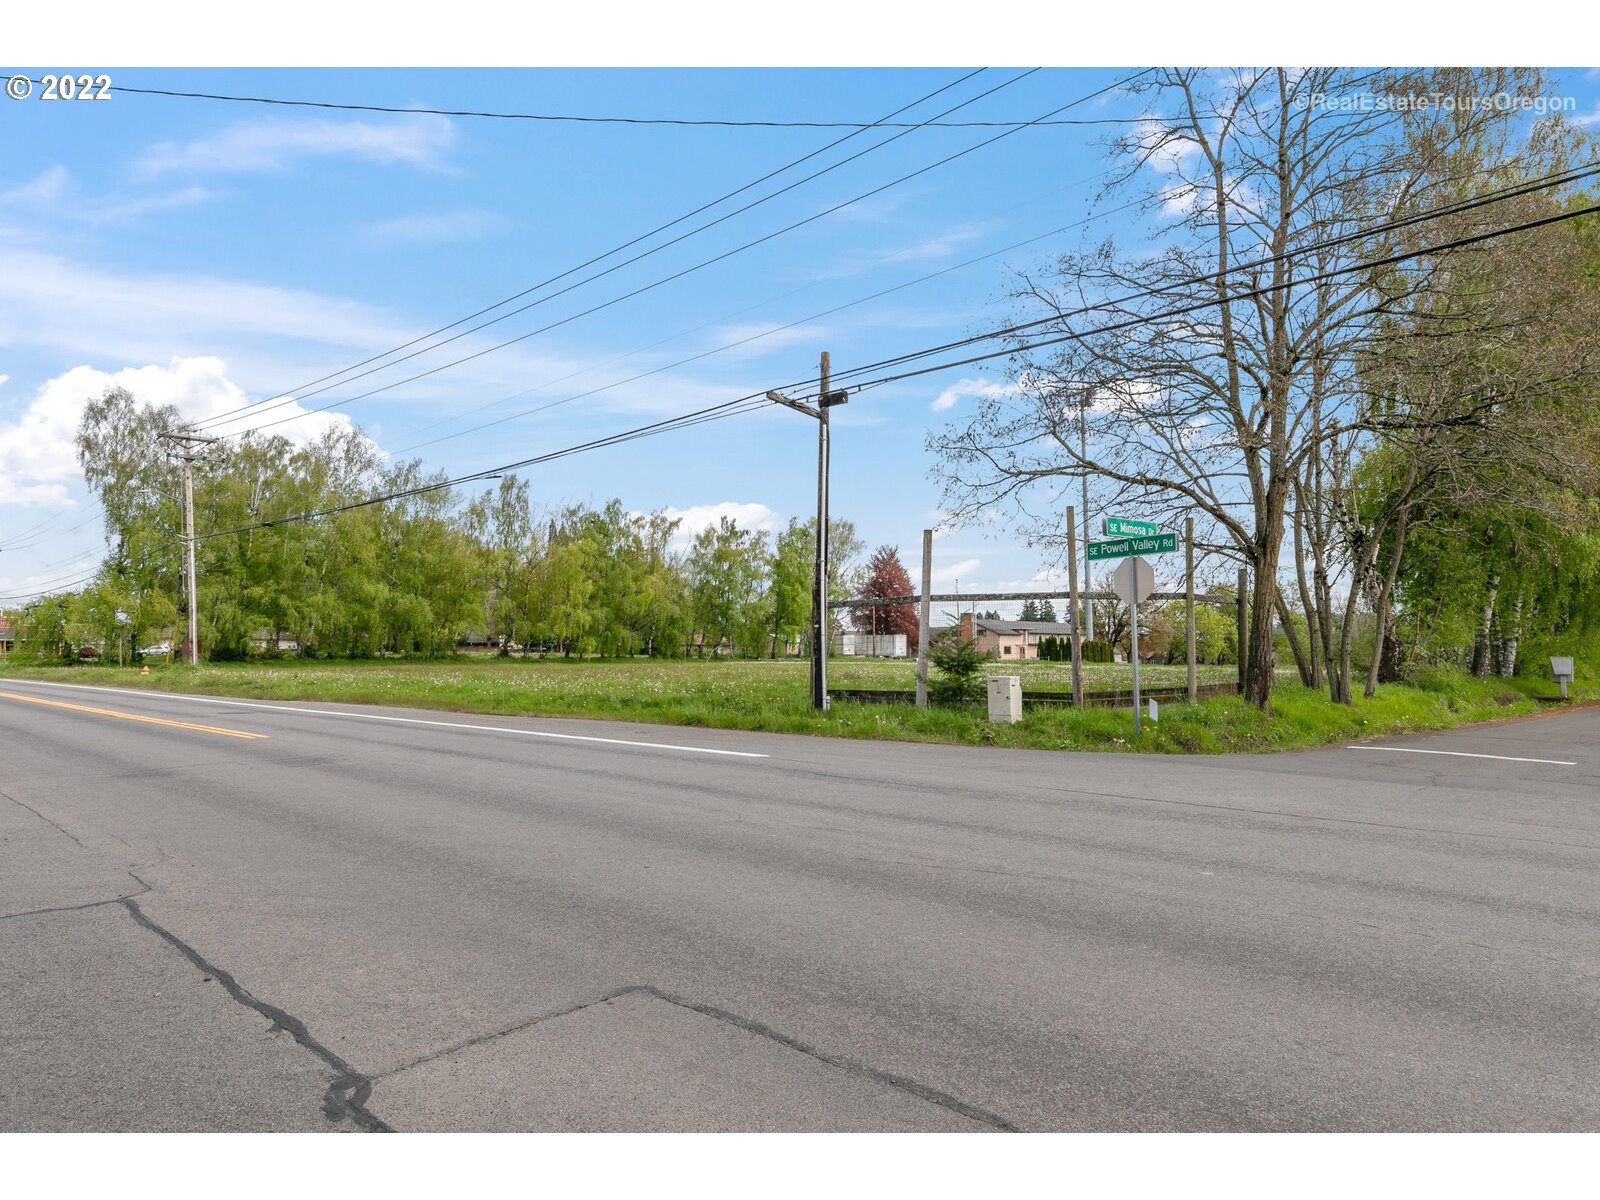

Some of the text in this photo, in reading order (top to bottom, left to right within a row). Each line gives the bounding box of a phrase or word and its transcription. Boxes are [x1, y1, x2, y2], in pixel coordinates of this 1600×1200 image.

[1110, 523, 1117, 532] SE
[1120, 522, 1146, 535] Mimosa
[1089, 538, 1173, 556] SE Powell Valley Rd
